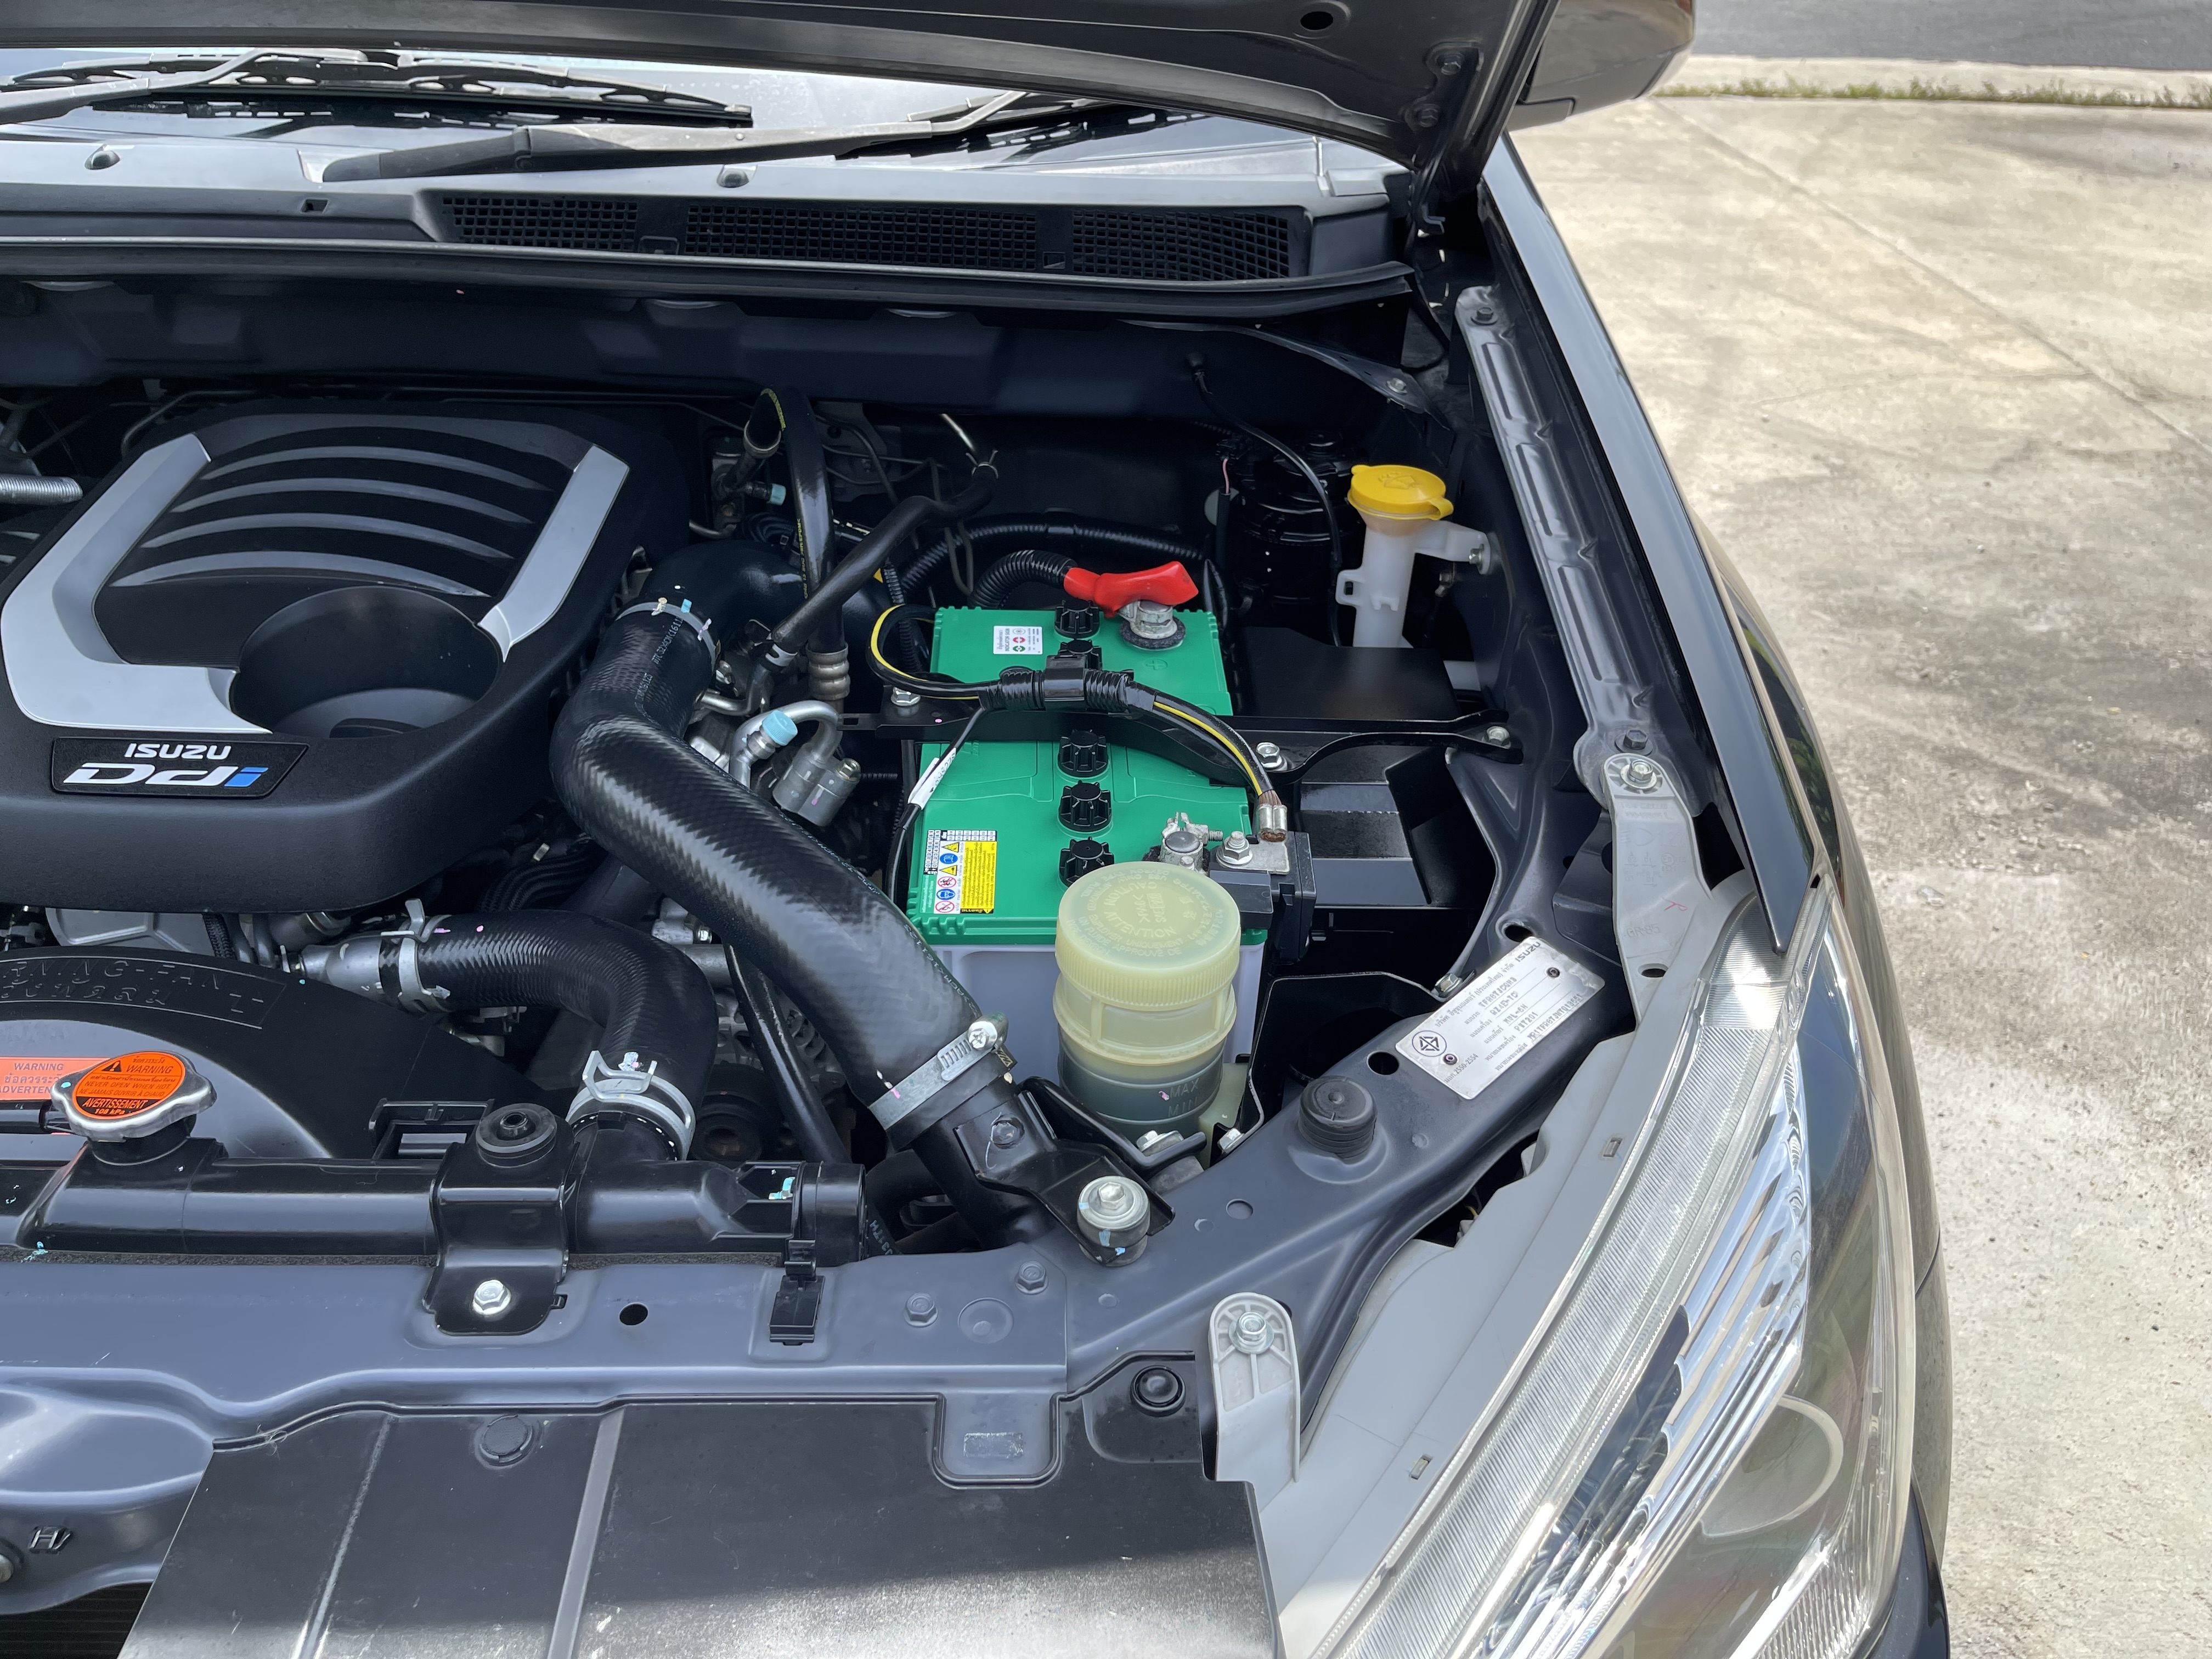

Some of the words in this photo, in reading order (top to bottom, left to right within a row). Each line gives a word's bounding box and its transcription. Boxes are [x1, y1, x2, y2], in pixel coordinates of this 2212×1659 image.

[124, 743, 232, 760] ISUZU
[1104, 881, 1158, 906] CAUTION
[1088, 914, 1122, 943] EMPLOYER
[1126, 938, 1184, 949] UNIQUEMENT
[1104, 911, 1176, 938] ATTENTION
[1084, 924, 1111, 947] FLUIDE
[1167, 947, 1182, 956] DE
[1515, 941, 1541, 963] ISUZU
[14, 1063, 64, 1071] WARNING
[126, 1065, 174, 1074] WARNING
[1169, 1077, 1200, 1097] MAX
[82, 1098, 149, 1109] AVERTISSEMENT
